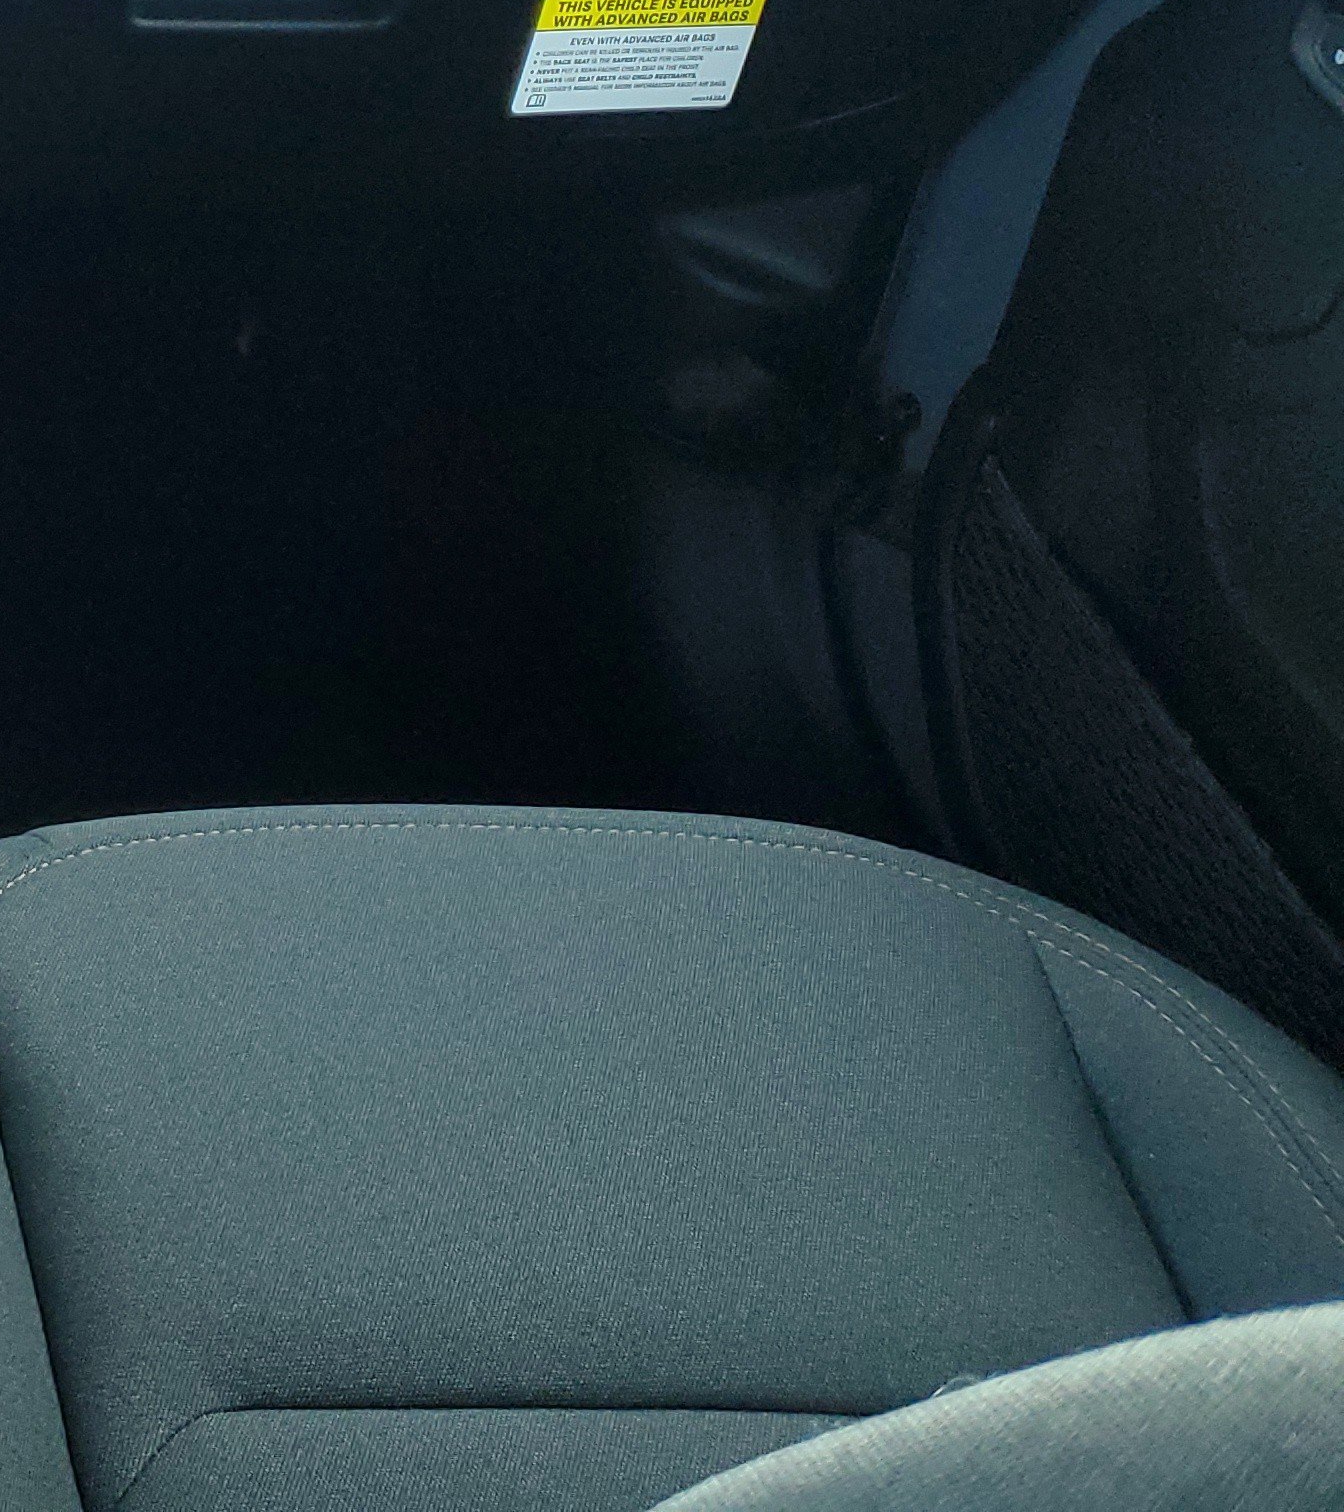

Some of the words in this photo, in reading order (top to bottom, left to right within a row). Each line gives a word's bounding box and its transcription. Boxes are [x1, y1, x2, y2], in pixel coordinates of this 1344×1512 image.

[558, 0, 592, 14] THIS
[596, 0, 658, 12] VEHICLE
[553, 14, 592, 28] WITH
[595, 12, 678, 26] ADVANCED
[680, 11, 706, 24] AIR
[709, 9, 749, 23] BAGS
[570, 37, 595, 46] EVEN
[597, 36, 621, 45] WITH
[622, 35, 672, 44] ADVANCED
[674, 34, 690, 43] AIR
[692, 34, 716, 43] BAGS
